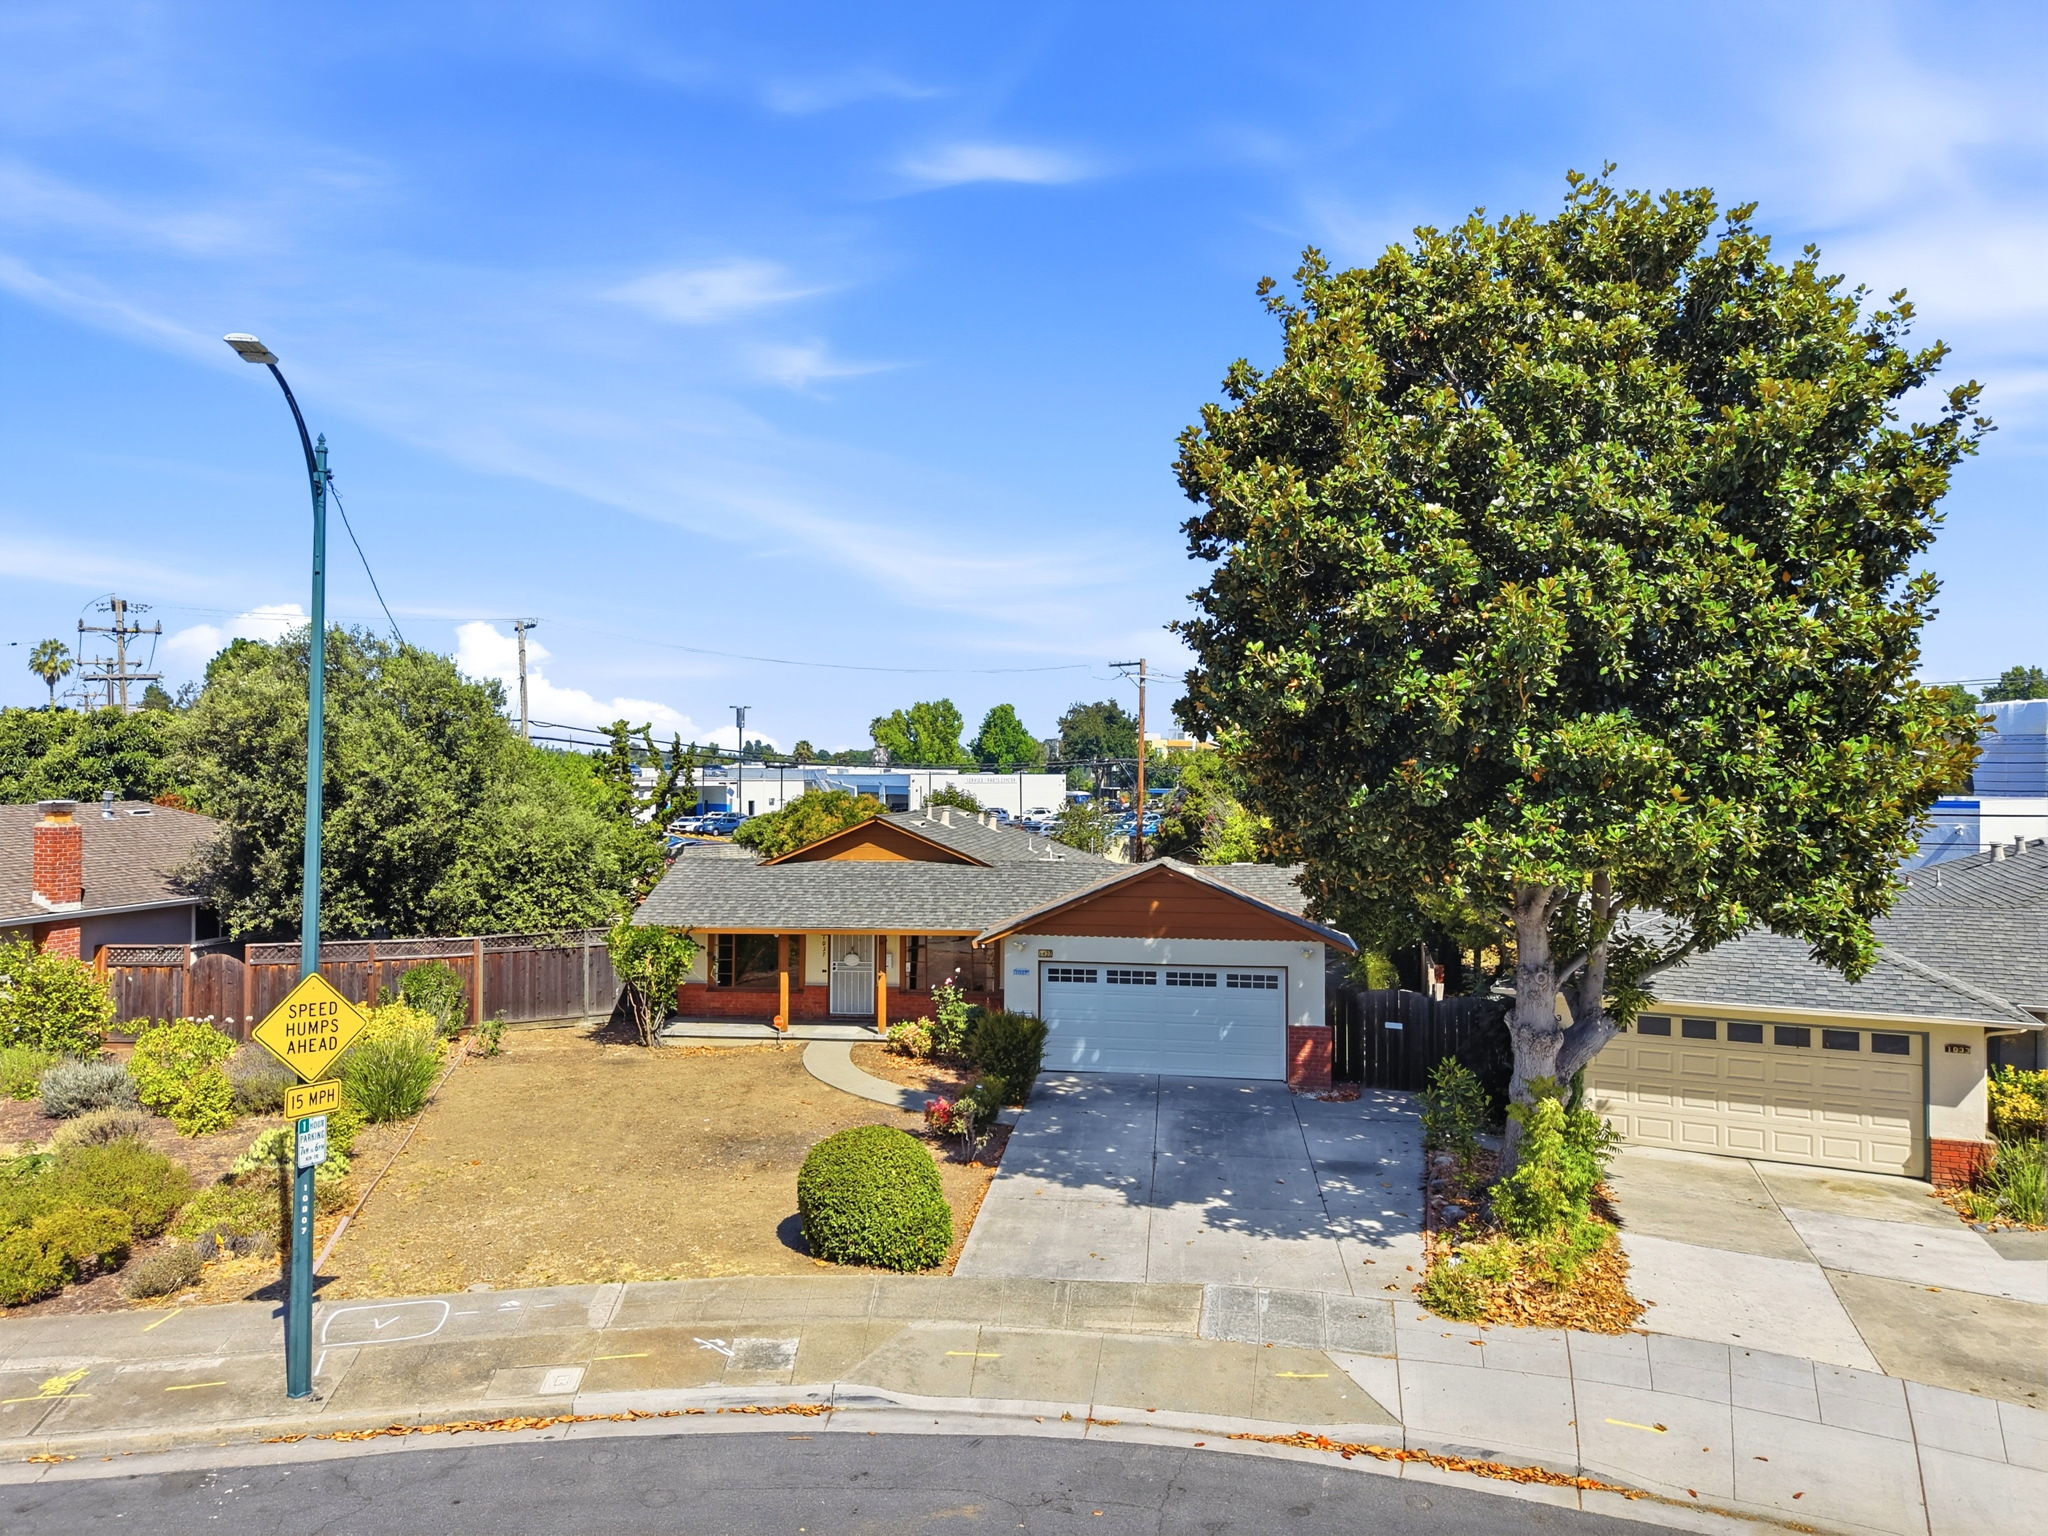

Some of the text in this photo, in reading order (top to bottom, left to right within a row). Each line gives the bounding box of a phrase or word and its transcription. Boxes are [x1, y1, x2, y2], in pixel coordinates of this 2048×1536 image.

[289, 1001, 338, 1019] SPEED
[286, 1018, 339, 1037] HUMPS
[286, 1036, 338, 1055] AHEAD
[291, 1088, 335, 1110] 15 MPH
[303, 1120, 307, 1132] 1
[300, 1130, 325, 1143] PARKING
